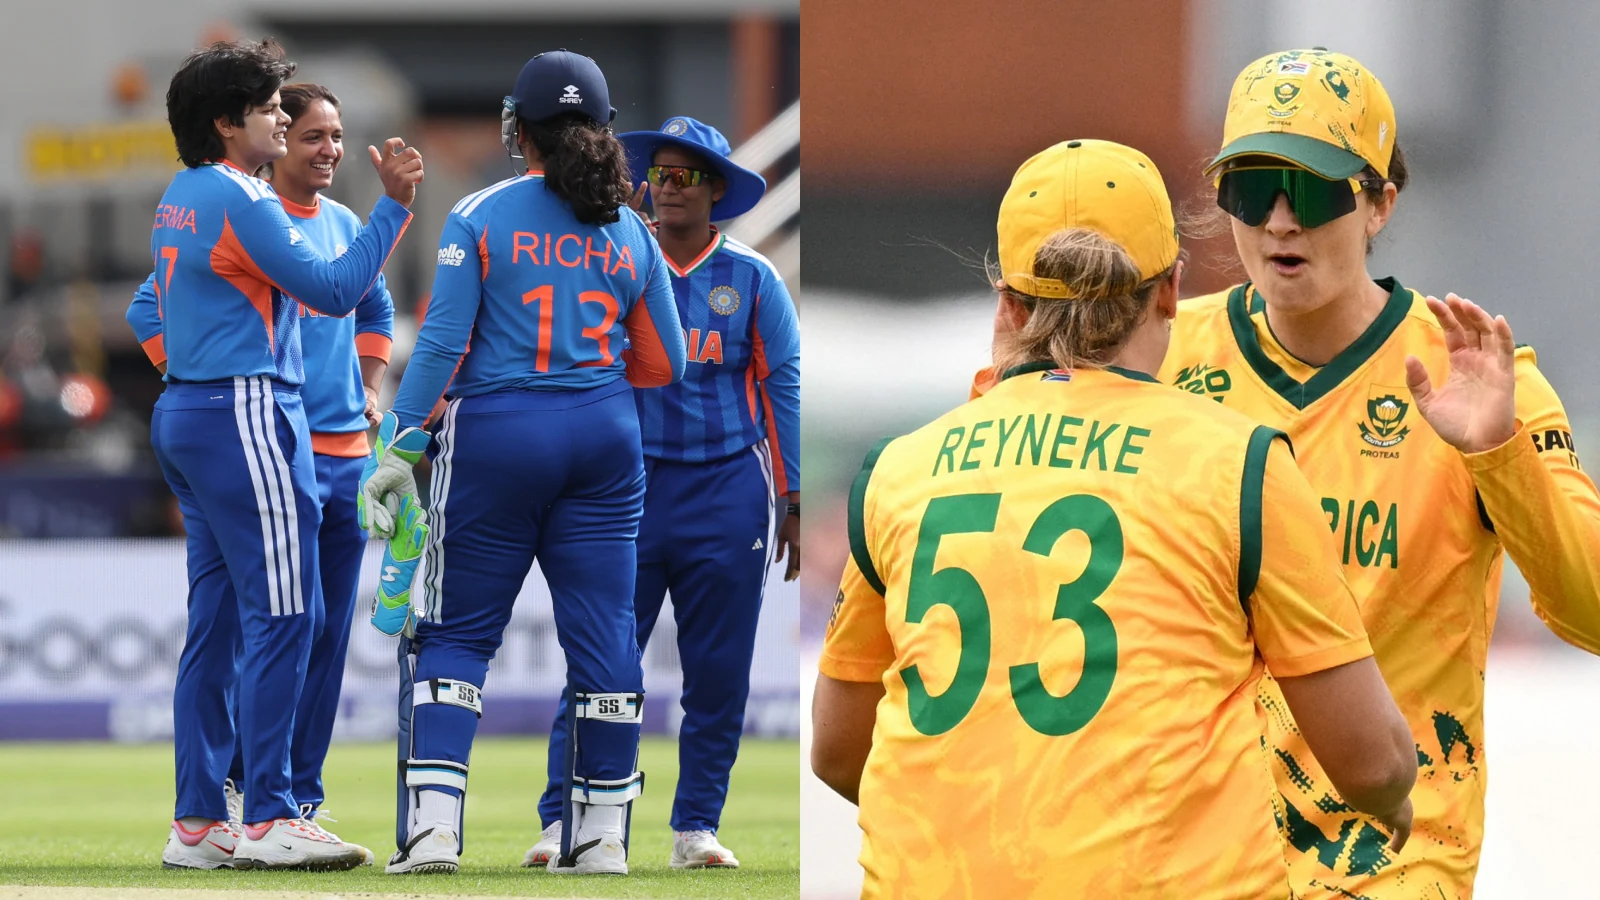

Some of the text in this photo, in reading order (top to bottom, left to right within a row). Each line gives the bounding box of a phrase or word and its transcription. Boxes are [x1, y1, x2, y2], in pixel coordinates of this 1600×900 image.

[154, 246, 178, 296] 7
[512, 231, 637, 280] RICHA
[522, 284, 619, 373] 13
[681, 327, 723, 365] IA
[1178, 369, 1232, 395] 20
[931, 413, 1152, 477] REYNEKE
[1360, 449, 1400, 459] PROTEAS
[1363, 434, 1382, 447] SOUTH
[900, 492, 1124, 736] 53
[458, 685, 475, 704] SS
[598, 699, 620, 714] SS
